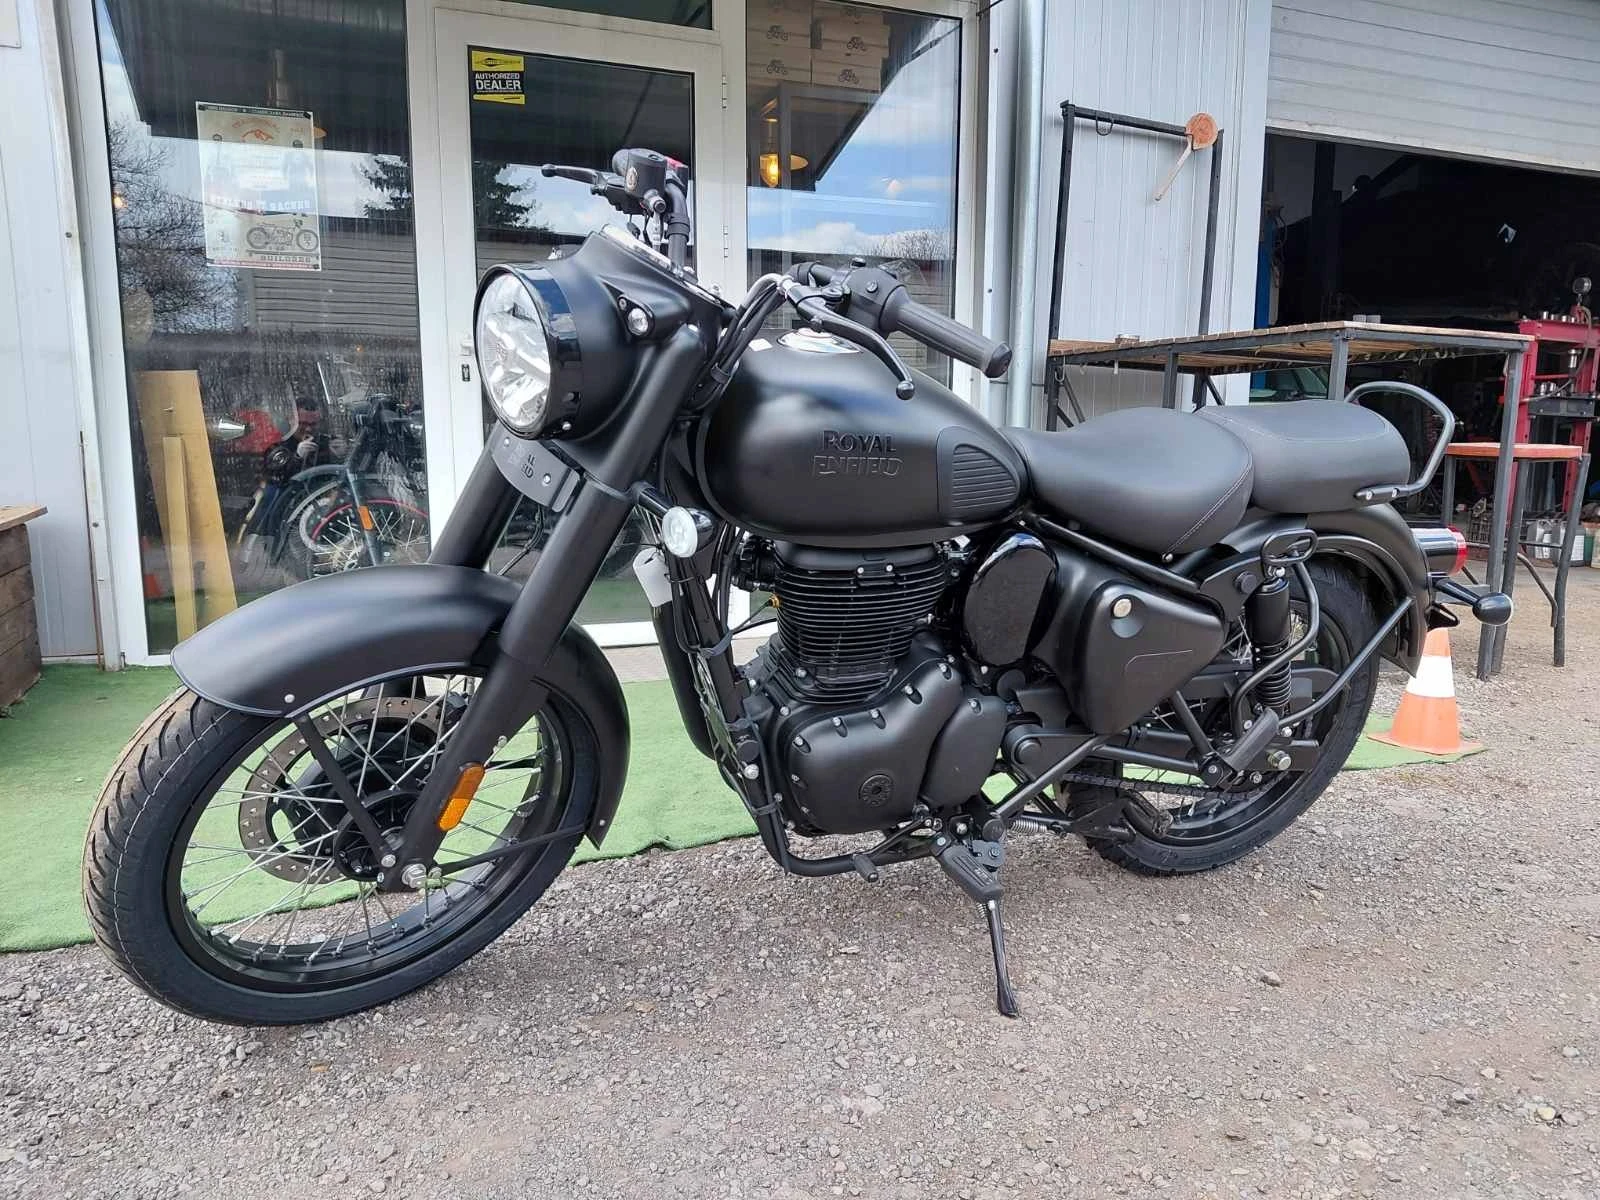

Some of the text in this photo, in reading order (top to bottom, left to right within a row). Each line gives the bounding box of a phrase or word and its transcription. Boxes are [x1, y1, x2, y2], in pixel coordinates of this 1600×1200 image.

[475, 72, 520, 80] AUTHORIZED
[475, 79, 521, 90] DEALER
[822, 430, 897, 453] ROYAL
[811, 455, 904, 476] ENFIELD
